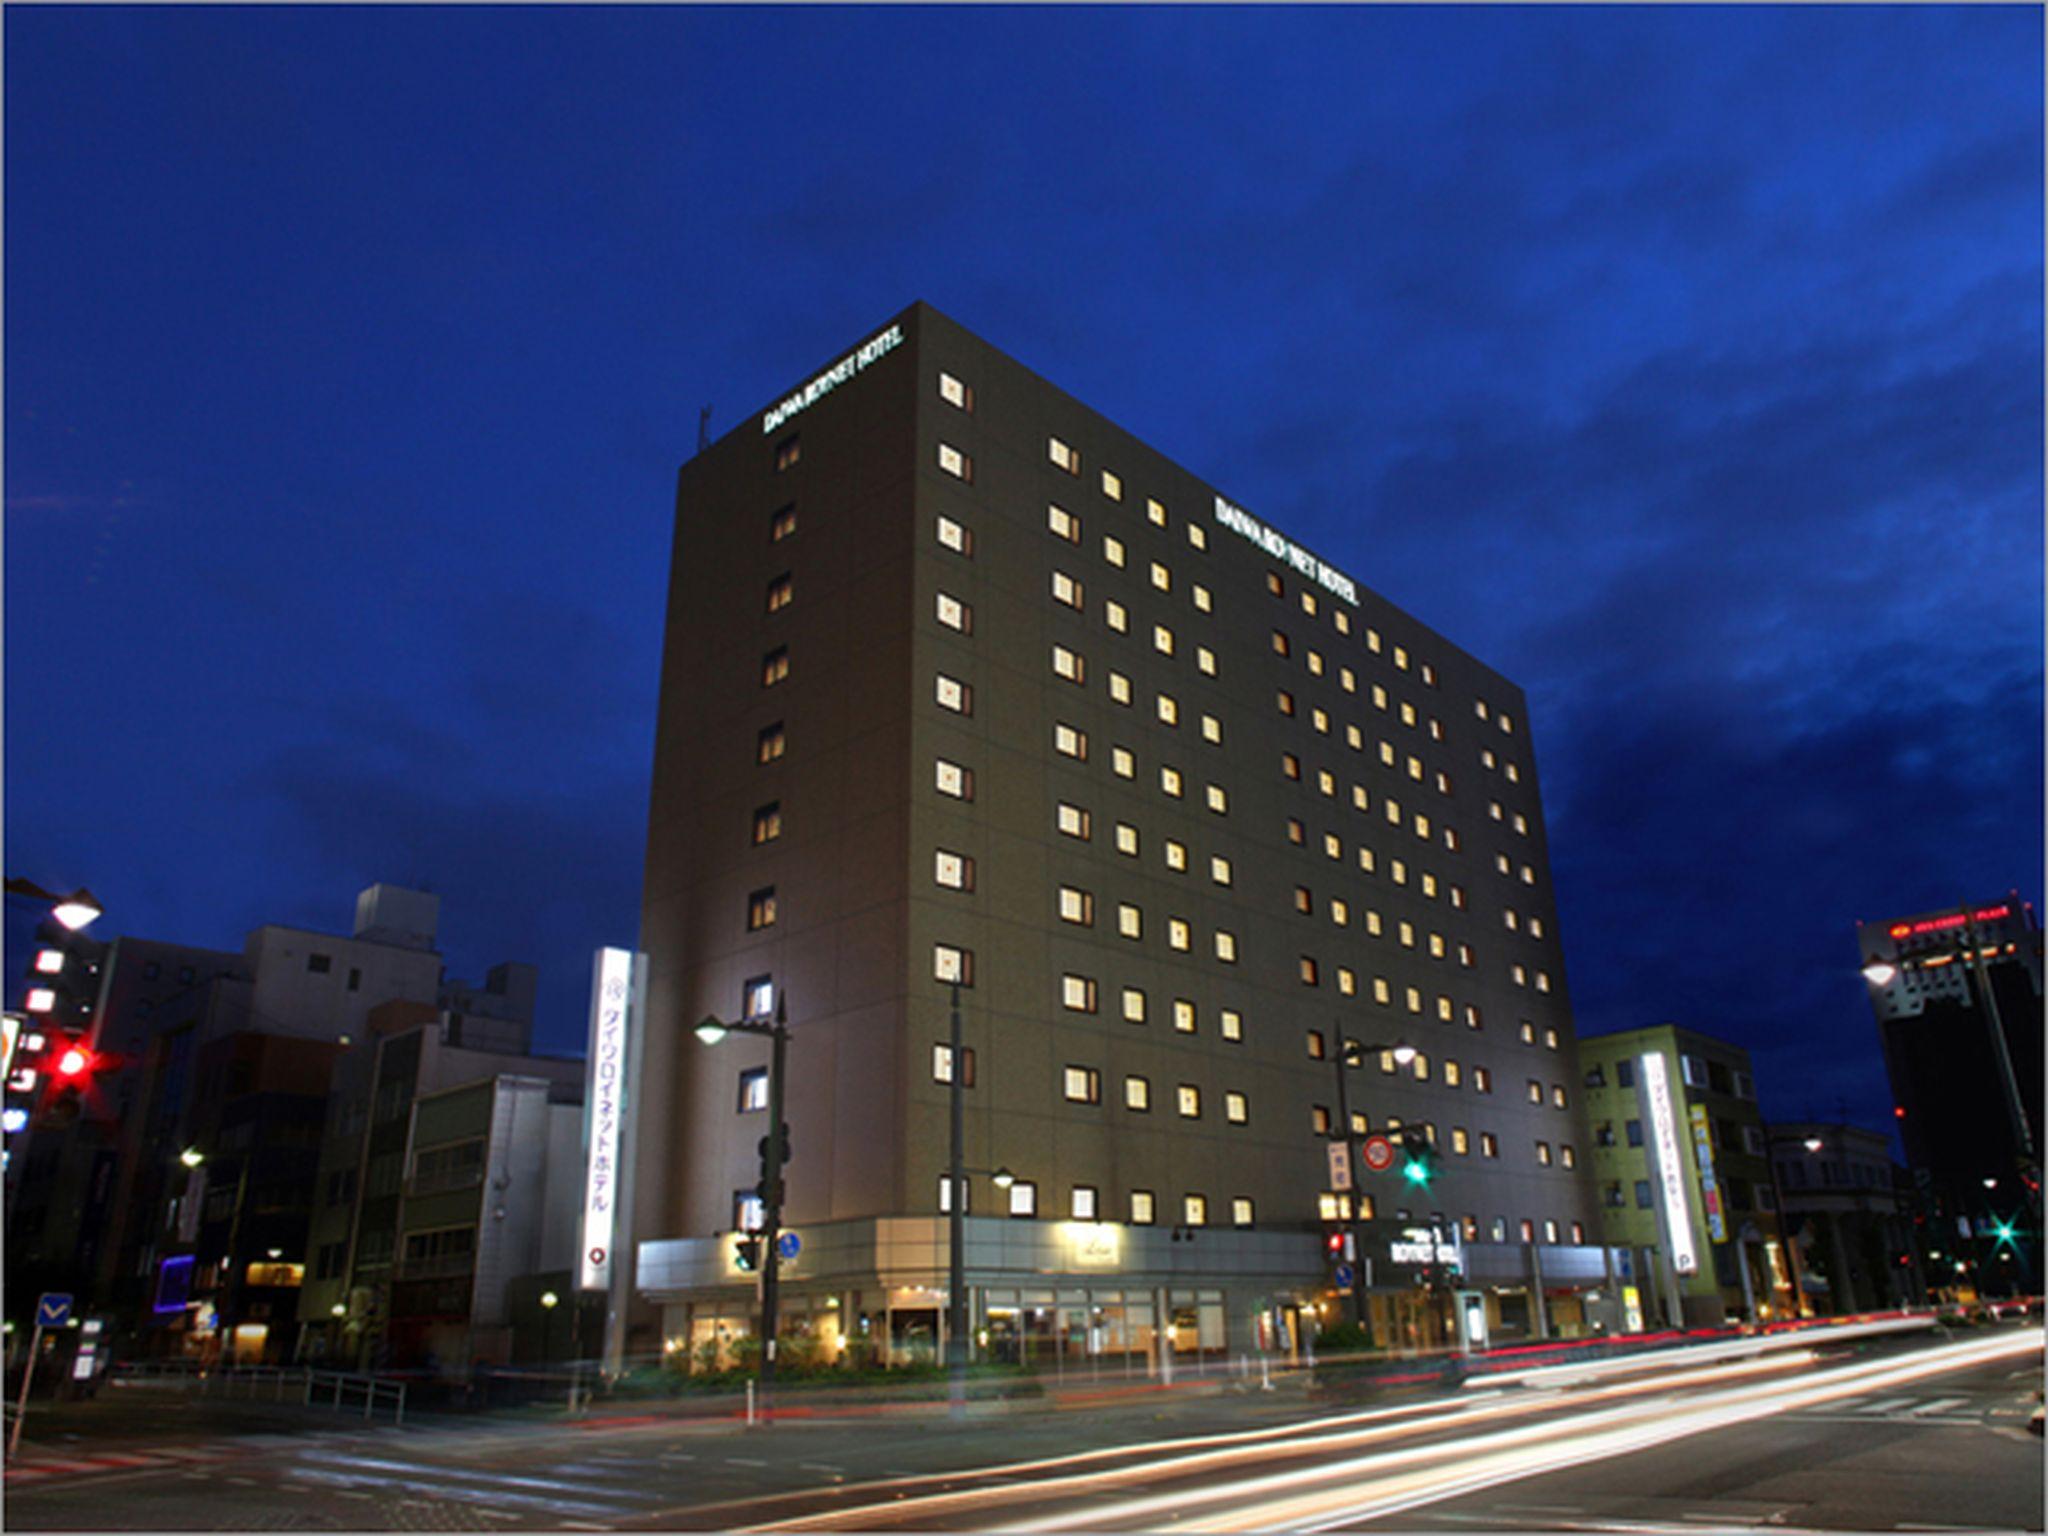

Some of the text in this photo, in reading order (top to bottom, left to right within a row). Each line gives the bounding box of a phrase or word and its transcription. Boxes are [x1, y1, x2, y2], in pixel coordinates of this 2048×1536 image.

[764, 393, 805, 434] DAIWA
[857, 325, 905, 371] HOTEL
[1316, 561, 1361, 608] HOTEL
